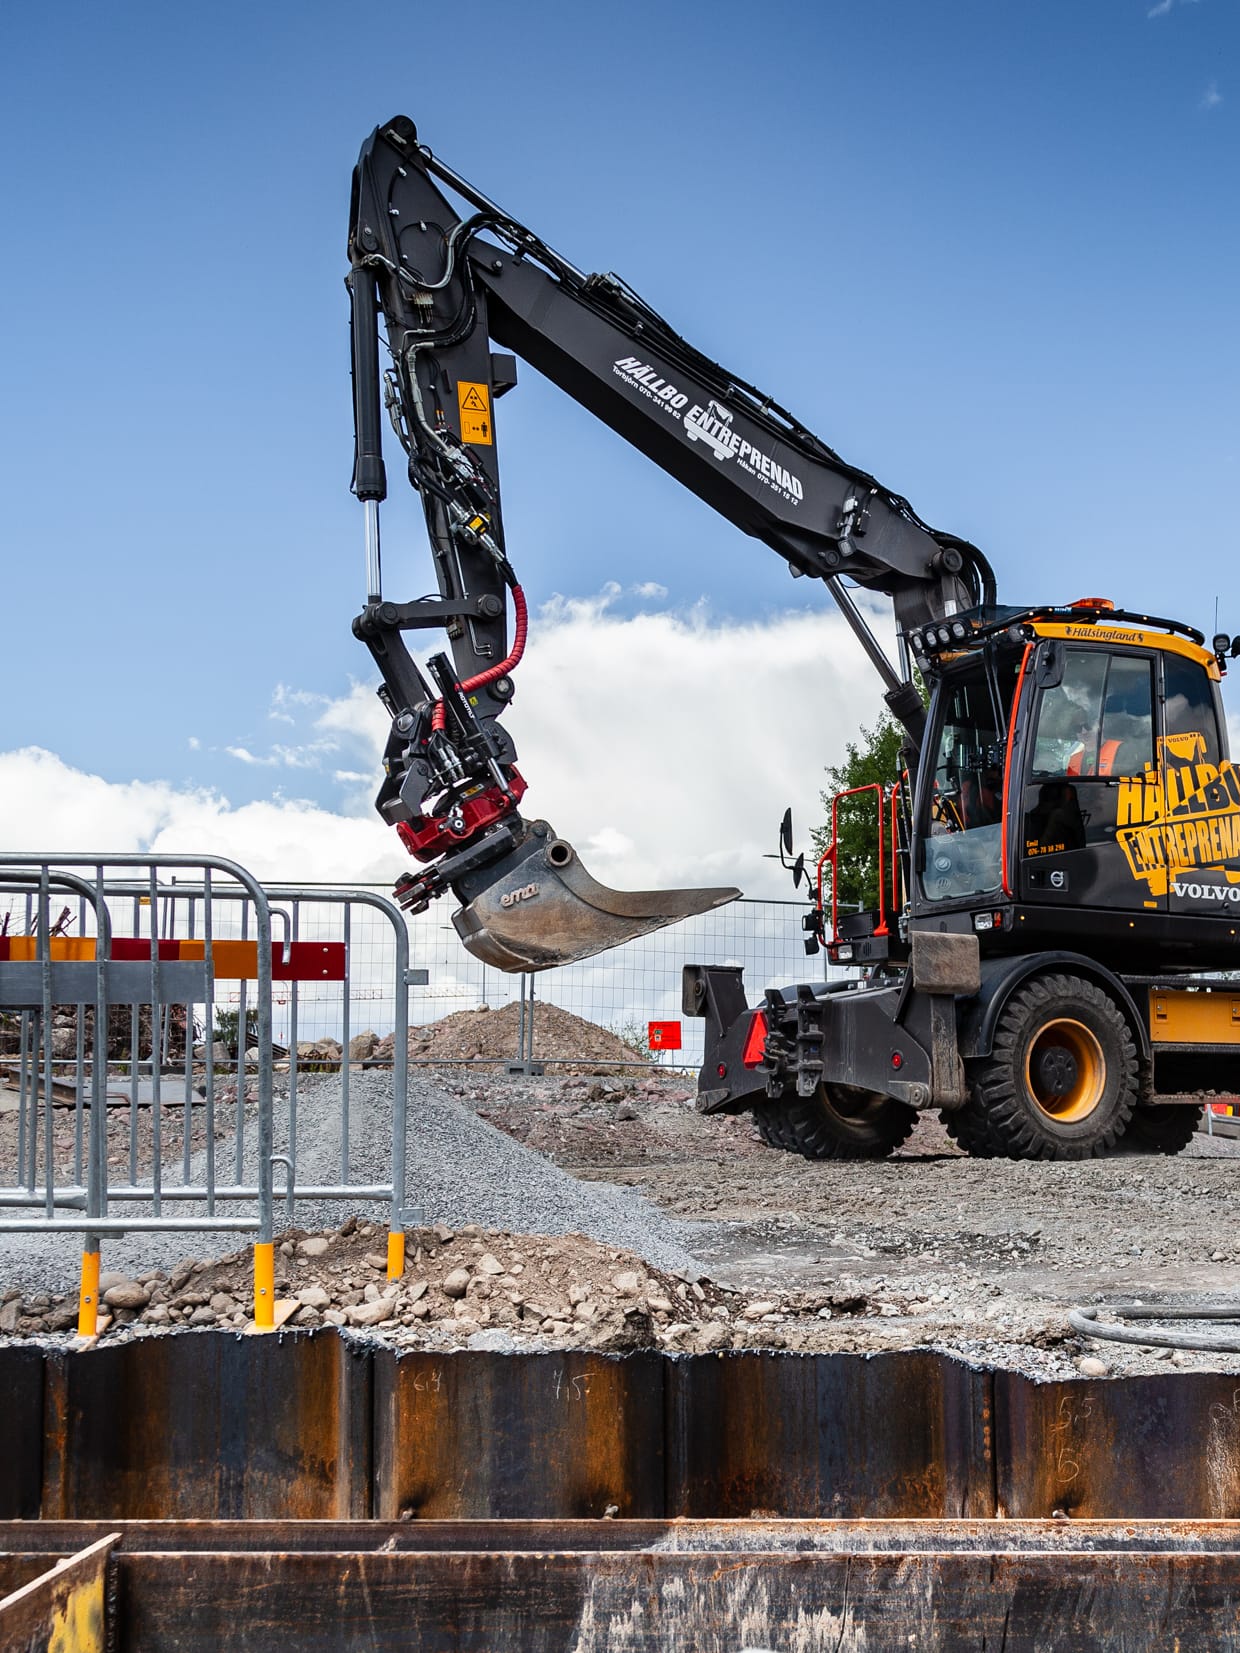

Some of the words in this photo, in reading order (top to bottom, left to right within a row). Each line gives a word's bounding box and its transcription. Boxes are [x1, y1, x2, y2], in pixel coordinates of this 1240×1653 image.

[613, 365, 639, 389] Torbjörn
[615, 357, 689, 408] HÄLLBO
[685, 405, 804, 500] ENTREPRENAD
[736, 458, 756, 476] Håkan
[1072, 627, 1136, 642] Hälsingland
[1168, 736, 1189, 744] VOLVO
